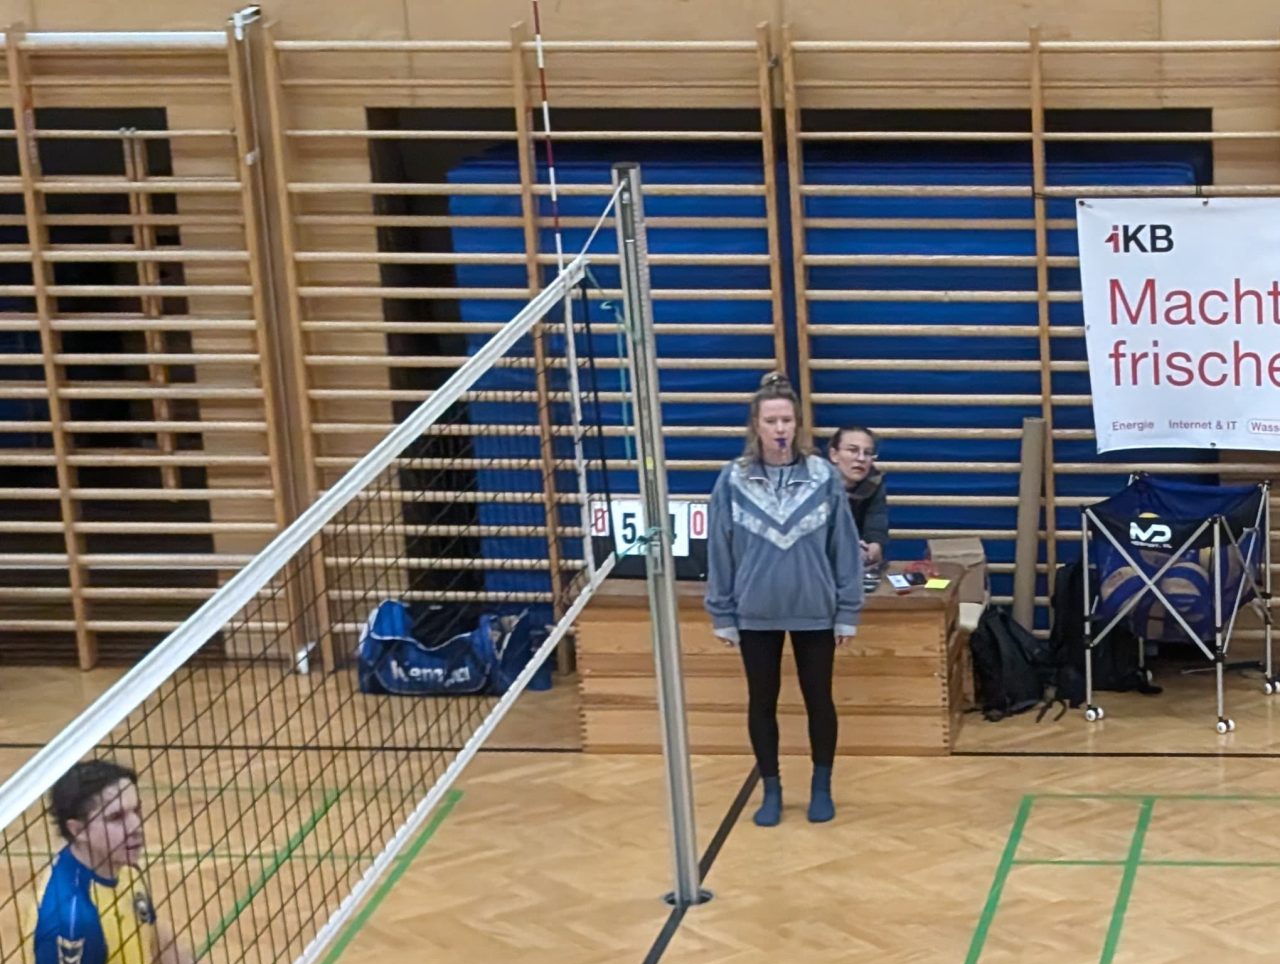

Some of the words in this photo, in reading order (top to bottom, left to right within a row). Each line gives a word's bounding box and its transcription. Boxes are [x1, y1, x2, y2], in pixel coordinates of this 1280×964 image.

[1112, 420, 1155, 432] Energie
[1168, 419, 1212, 430] Internet
[1215, 420, 1223, 430] &
[1226, 420, 1238, 431] IT
[621, 512, 637, 544] 5
[692, 510, 705, 536] 0
